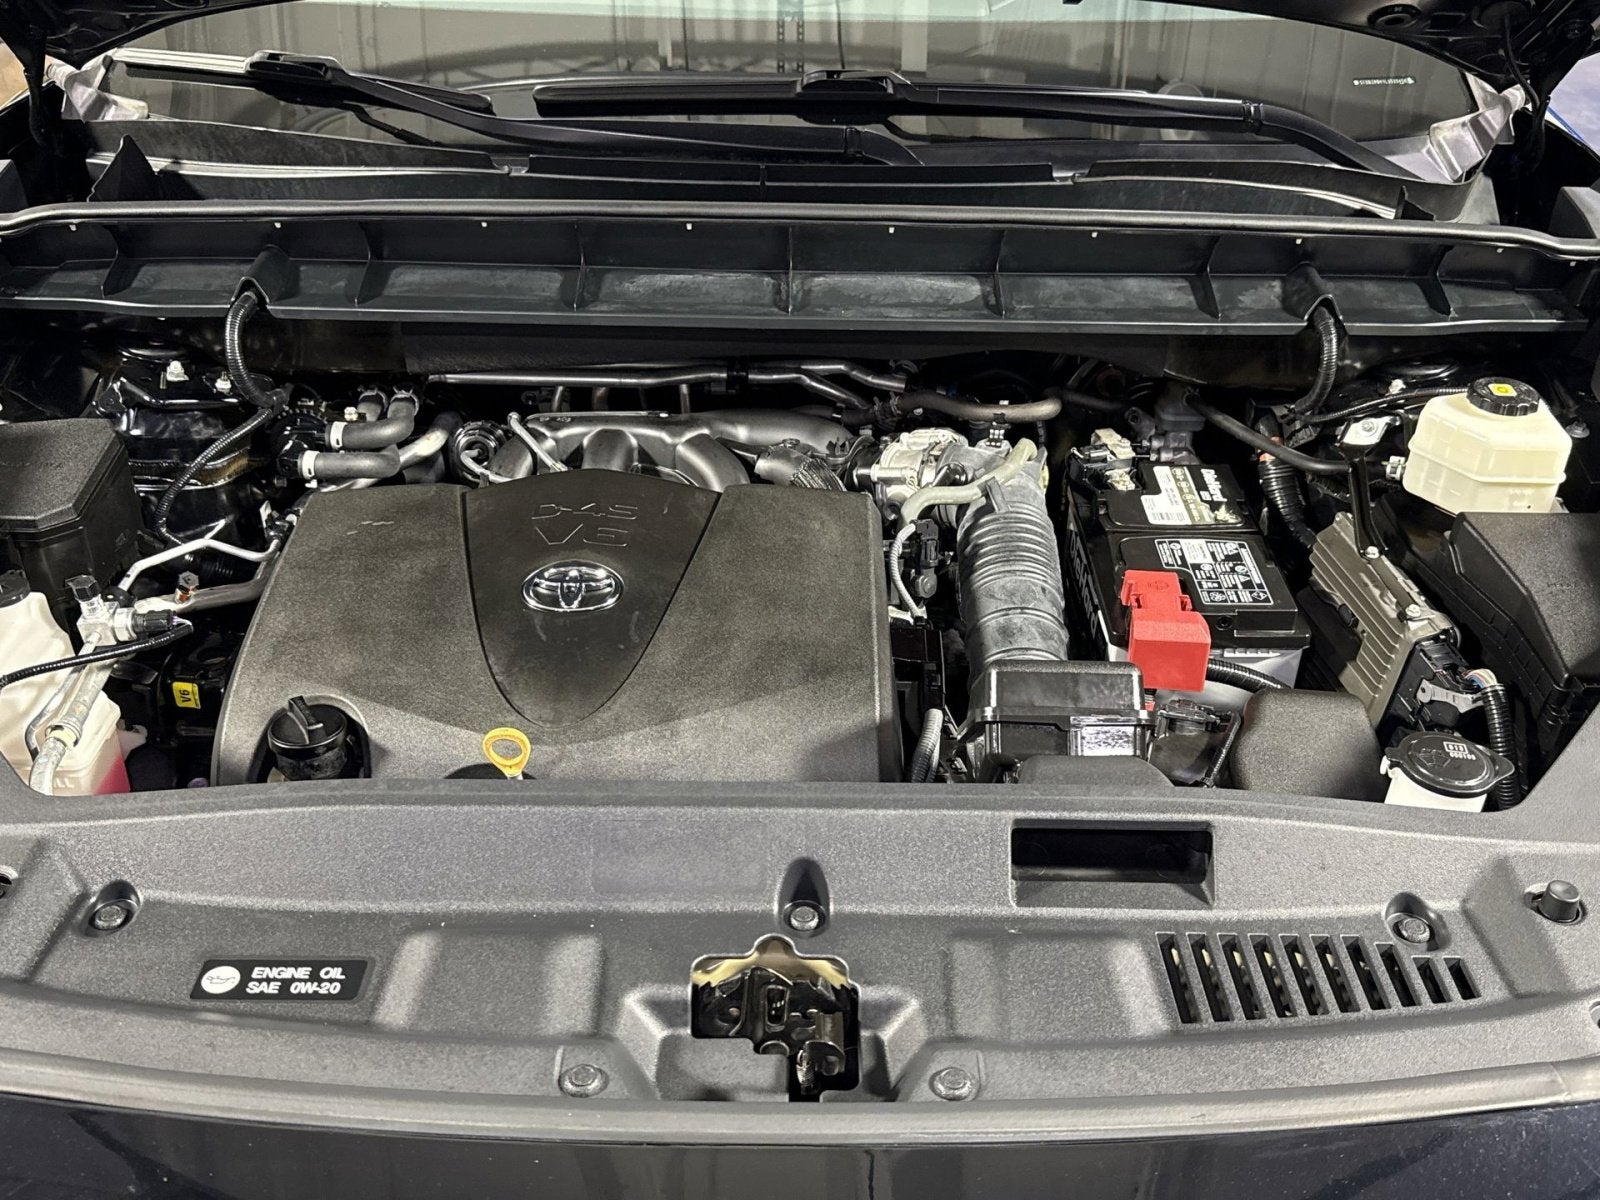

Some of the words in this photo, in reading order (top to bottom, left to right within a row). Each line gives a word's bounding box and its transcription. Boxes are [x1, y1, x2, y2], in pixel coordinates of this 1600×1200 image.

[534, 523, 629, 547] V6
[251, 966, 312, 979] ENGINE
[319, 966, 346, 979] OIL
[246, 981, 281, 994] SAE
[289, 981, 341, 994] 0W-20
